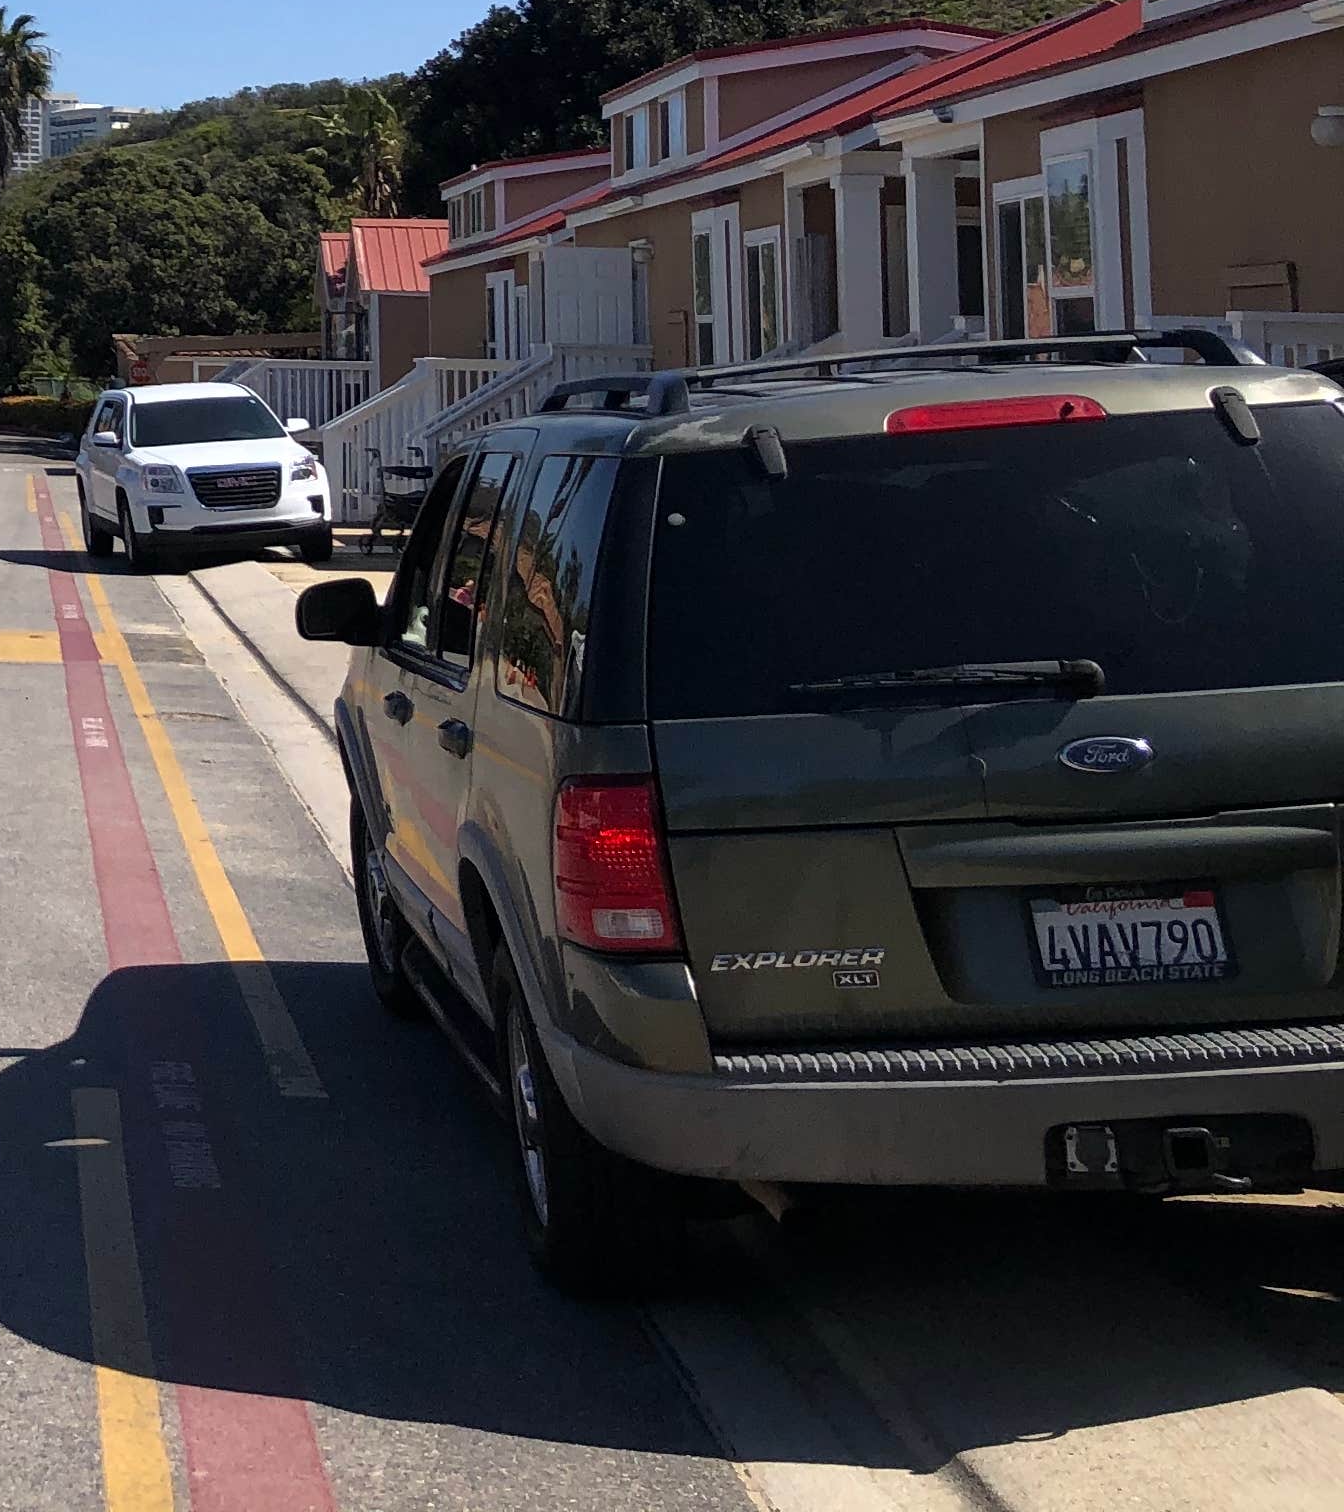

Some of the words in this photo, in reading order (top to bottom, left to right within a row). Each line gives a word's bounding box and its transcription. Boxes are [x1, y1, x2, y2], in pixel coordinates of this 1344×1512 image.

[1083, 744, 1130, 764] Ford
[1048, 919, 1218, 971] 4VAV790
[711, 948, 885, 972] EXPLORER
[839, 973, 874, 984] XLT
[1052, 969, 1100, 985] LONG
[1105, 966, 1163, 983] BEACH
[1168, 963, 1225, 979] STATE
